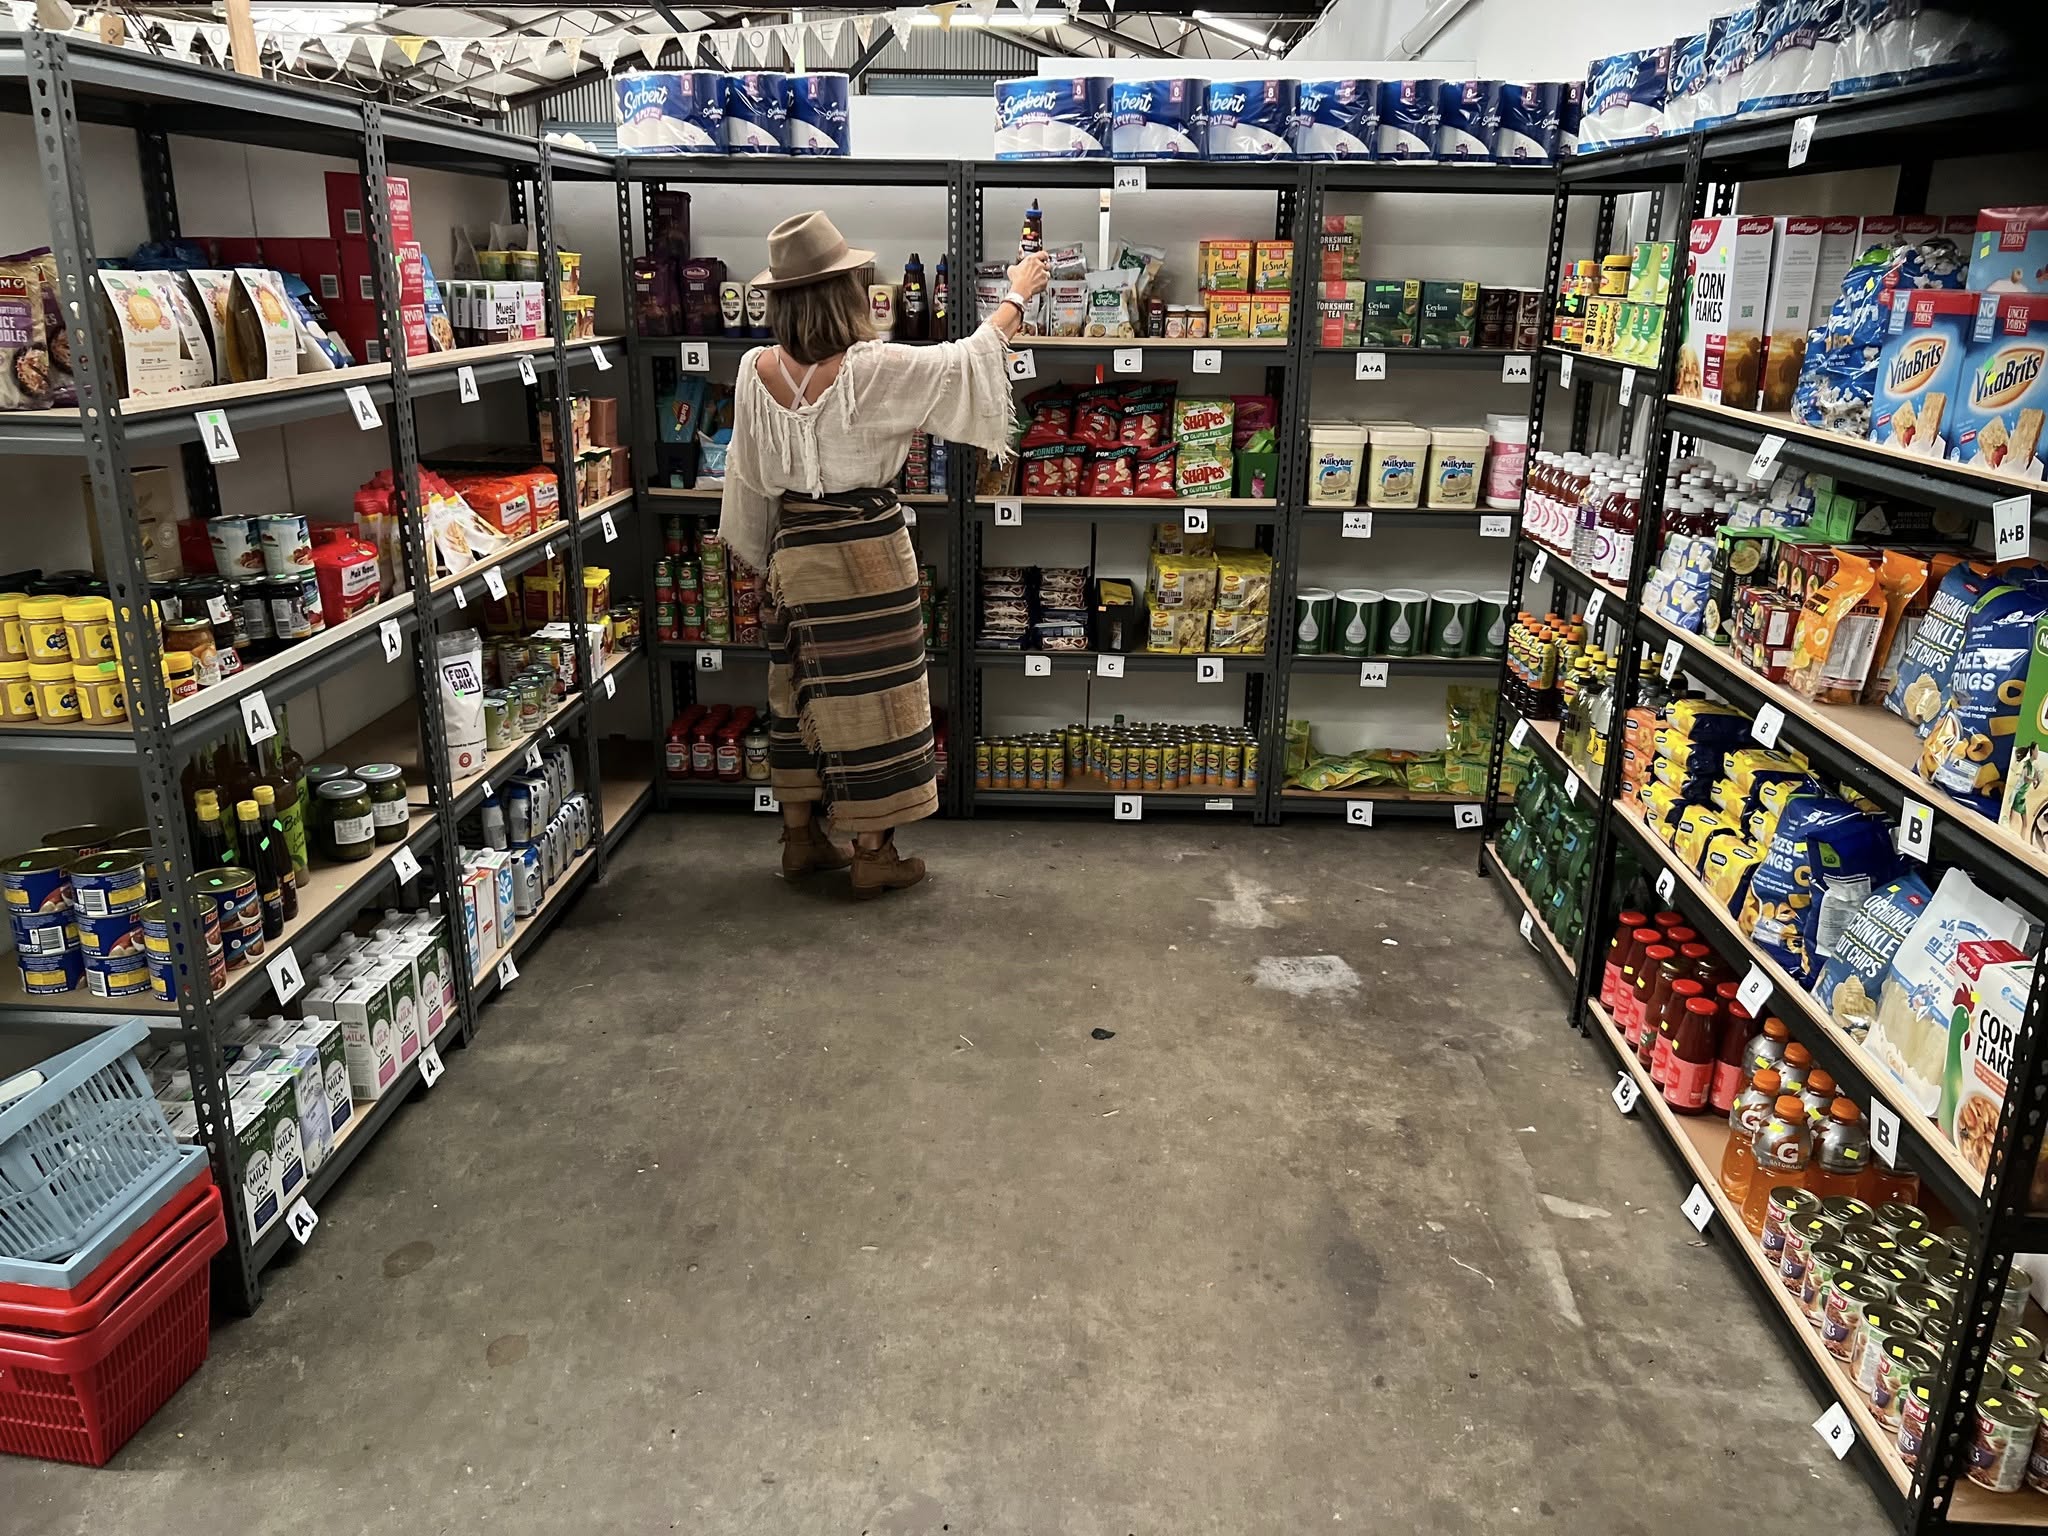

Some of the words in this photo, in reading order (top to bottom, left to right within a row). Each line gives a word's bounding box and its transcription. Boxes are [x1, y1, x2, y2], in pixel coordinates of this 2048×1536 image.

[1658, 56, 1665, 68] 8
[1075, 85, 1081, 95] 8
[1173, 84, 1179, 95] 8
[1267, 84, 1273, 96] 8
[1344, 87, 1351, 97] 8
[1404, 86, 1411, 97] 8
[1466, 87, 1473, 97] 8
[1570, 86, 1575, 98] 8
[1588, 64, 1640, 107] Sorbent
[624, 87, 668, 118] Sorbent
[1525, 91, 1531, 101] 8
[1002, 90, 1056, 124] Sorbent
[1114, 94, 1151, 115] rbent
[1211, 94, 1244, 113] bent
[1600, 98, 1607, 113] 3
[1607, 93, 1618, 109] PLY
[1793, 139, 1806, 155] A+B
[1118, 179, 1139, 188] A+B
[1741, 222, 1769, 233] Kellogg's
[1790, 221, 1819, 233] Kellogg's
[2004, 224, 2027, 238] UNCLE
[1320, 235, 1353, 245] ORKSHIRE
[2001, 236, 2024, 249] TOBYS
[400, 247, 420, 262] RYVITA
[1327, 244, 1340, 252] TEA
[1697, 272, 1726, 300] CORN
[496, 301, 516, 315] Muesli
[525, 300, 541, 313] Muesli
[1316, 301, 1354, 313] YORKSHIRE
[1368, 302, 1390, 312] Ceylon
[1426, 304, 1448, 313] Ceylon
[1694, 300, 1723, 323] FLAKES
[1894, 300, 1907, 312] NO
[1915, 302, 1934, 313] UNCLE
[1979, 302, 1996, 317] NO
[405, 310, 424, 324] RYVITA
[496, 314, 508, 325] Bars
[1327, 310, 1340, 319] TEA
[1368, 309, 1380, 317] Tea
[1426, 310, 1438, 318] Tea
[1914, 313, 1932, 323] TOBYS
[2007, 308, 2029, 320] UNCLE
[0, 316, 15, 328] ICE
[2005, 319, 2027, 332] TOBYS
[688, 352, 699, 364] B
[1205, 358, 1212, 366] C
[524, 367, 532, 381] A
[1014, 361, 1025, 374] C
[1361, 363, 1382, 373] A+A
[1506, 367, 1527, 377] A+A
[1890, 345, 1941, 390] VitaBrits
[465, 377, 474, 396] A
[358, 401, 371, 422] A
[211, 425, 229, 450] A
[1187, 432, 1209, 442] GLUTEN
[1210, 431, 1223, 439] FREE
[1023, 445, 1065, 459] POPCORNERS
[1096, 447, 1138, 459] POPCORNERS
[1319, 457, 1354, 469] Milkybar
[1382, 458, 1417, 470] Milkybar
[1440, 459, 1476, 470] Milkybar
[1754, 455, 1770, 469] A+B
[1187, 485, 1209, 495] GLUTEN
[1210, 483, 1223, 492] FREE
[1000, 507, 1012, 521] D
[605, 521, 613, 535] B
[1188, 515, 1200, 529] D
[1344, 522, 1366, 530] A+A+B
[1485, 528, 1505, 536] A+A+B
[2000, 524, 2025, 546] A+B
[1532, 560, 1541, 575] C
[494, 578, 500, 590] A
[1589, 599, 1598, 615] C
[1918, 611, 1963, 651] CRINKLE
[389, 633, 398, 653] A
[702, 656, 713, 669] B
[1663, 655, 1672, 670] B
[1921, 643, 1951, 673] CHIPS
[1035, 663, 1041, 671] C
[1108, 661, 1115, 670] C
[1203, 664, 1214, 678] D
[448, 667, 471, 681] FOOD
[1365, 673, 1384, 683] A+A
[452, 678, 475, 692] BANK
[1972, 711, 1987, 720] more
[1980, 705, 1997, 713] back
[251, 709, 267, 734] A
[1760, 722, 1768, 735] B
[530, 753, 536, 765] A
[760, 795, 771, 808] B
[1122, 802, 1133, 814] D
[1352, 807, 1363, 820] C
[1461, 810, 1473, 825] C
[1909, 816, 1926, 844] B
[403, 861, 411, 873] A
[1767, 852, 1794, 873] NGS
[1862, 894, 1918, 936] ORIGINAL
[1847, 910, 1902, 963] CRINKLE
[1846, 946, 1883, 979] CHIPS
[503, 965, 510, 979] A
[280, 967, 294, 991] A
[1750, 982, 1759, 993] B
[344, 1029, 367, 1044] MILK
[1979, 1008, 2012, 1057] COR
[426, 1061, 436, 1078] A
[327, 1071, 344, 1094] MILK
[1741, 1110, 1761, 1131] G
[1876, 1112, 1890, 1148] B
[276, 1130, 296, 1155] MILK
[1777, 1143, 1799, 1164] G
[1769, 1160, 1803, 1170] GATORADE
[248, 1162, 270, 1189] MILK
[1693, 1203, 1701, 1216] B
[294, 1212, 311, 1237] A
[1831, 1424, 1843, 1440] B
